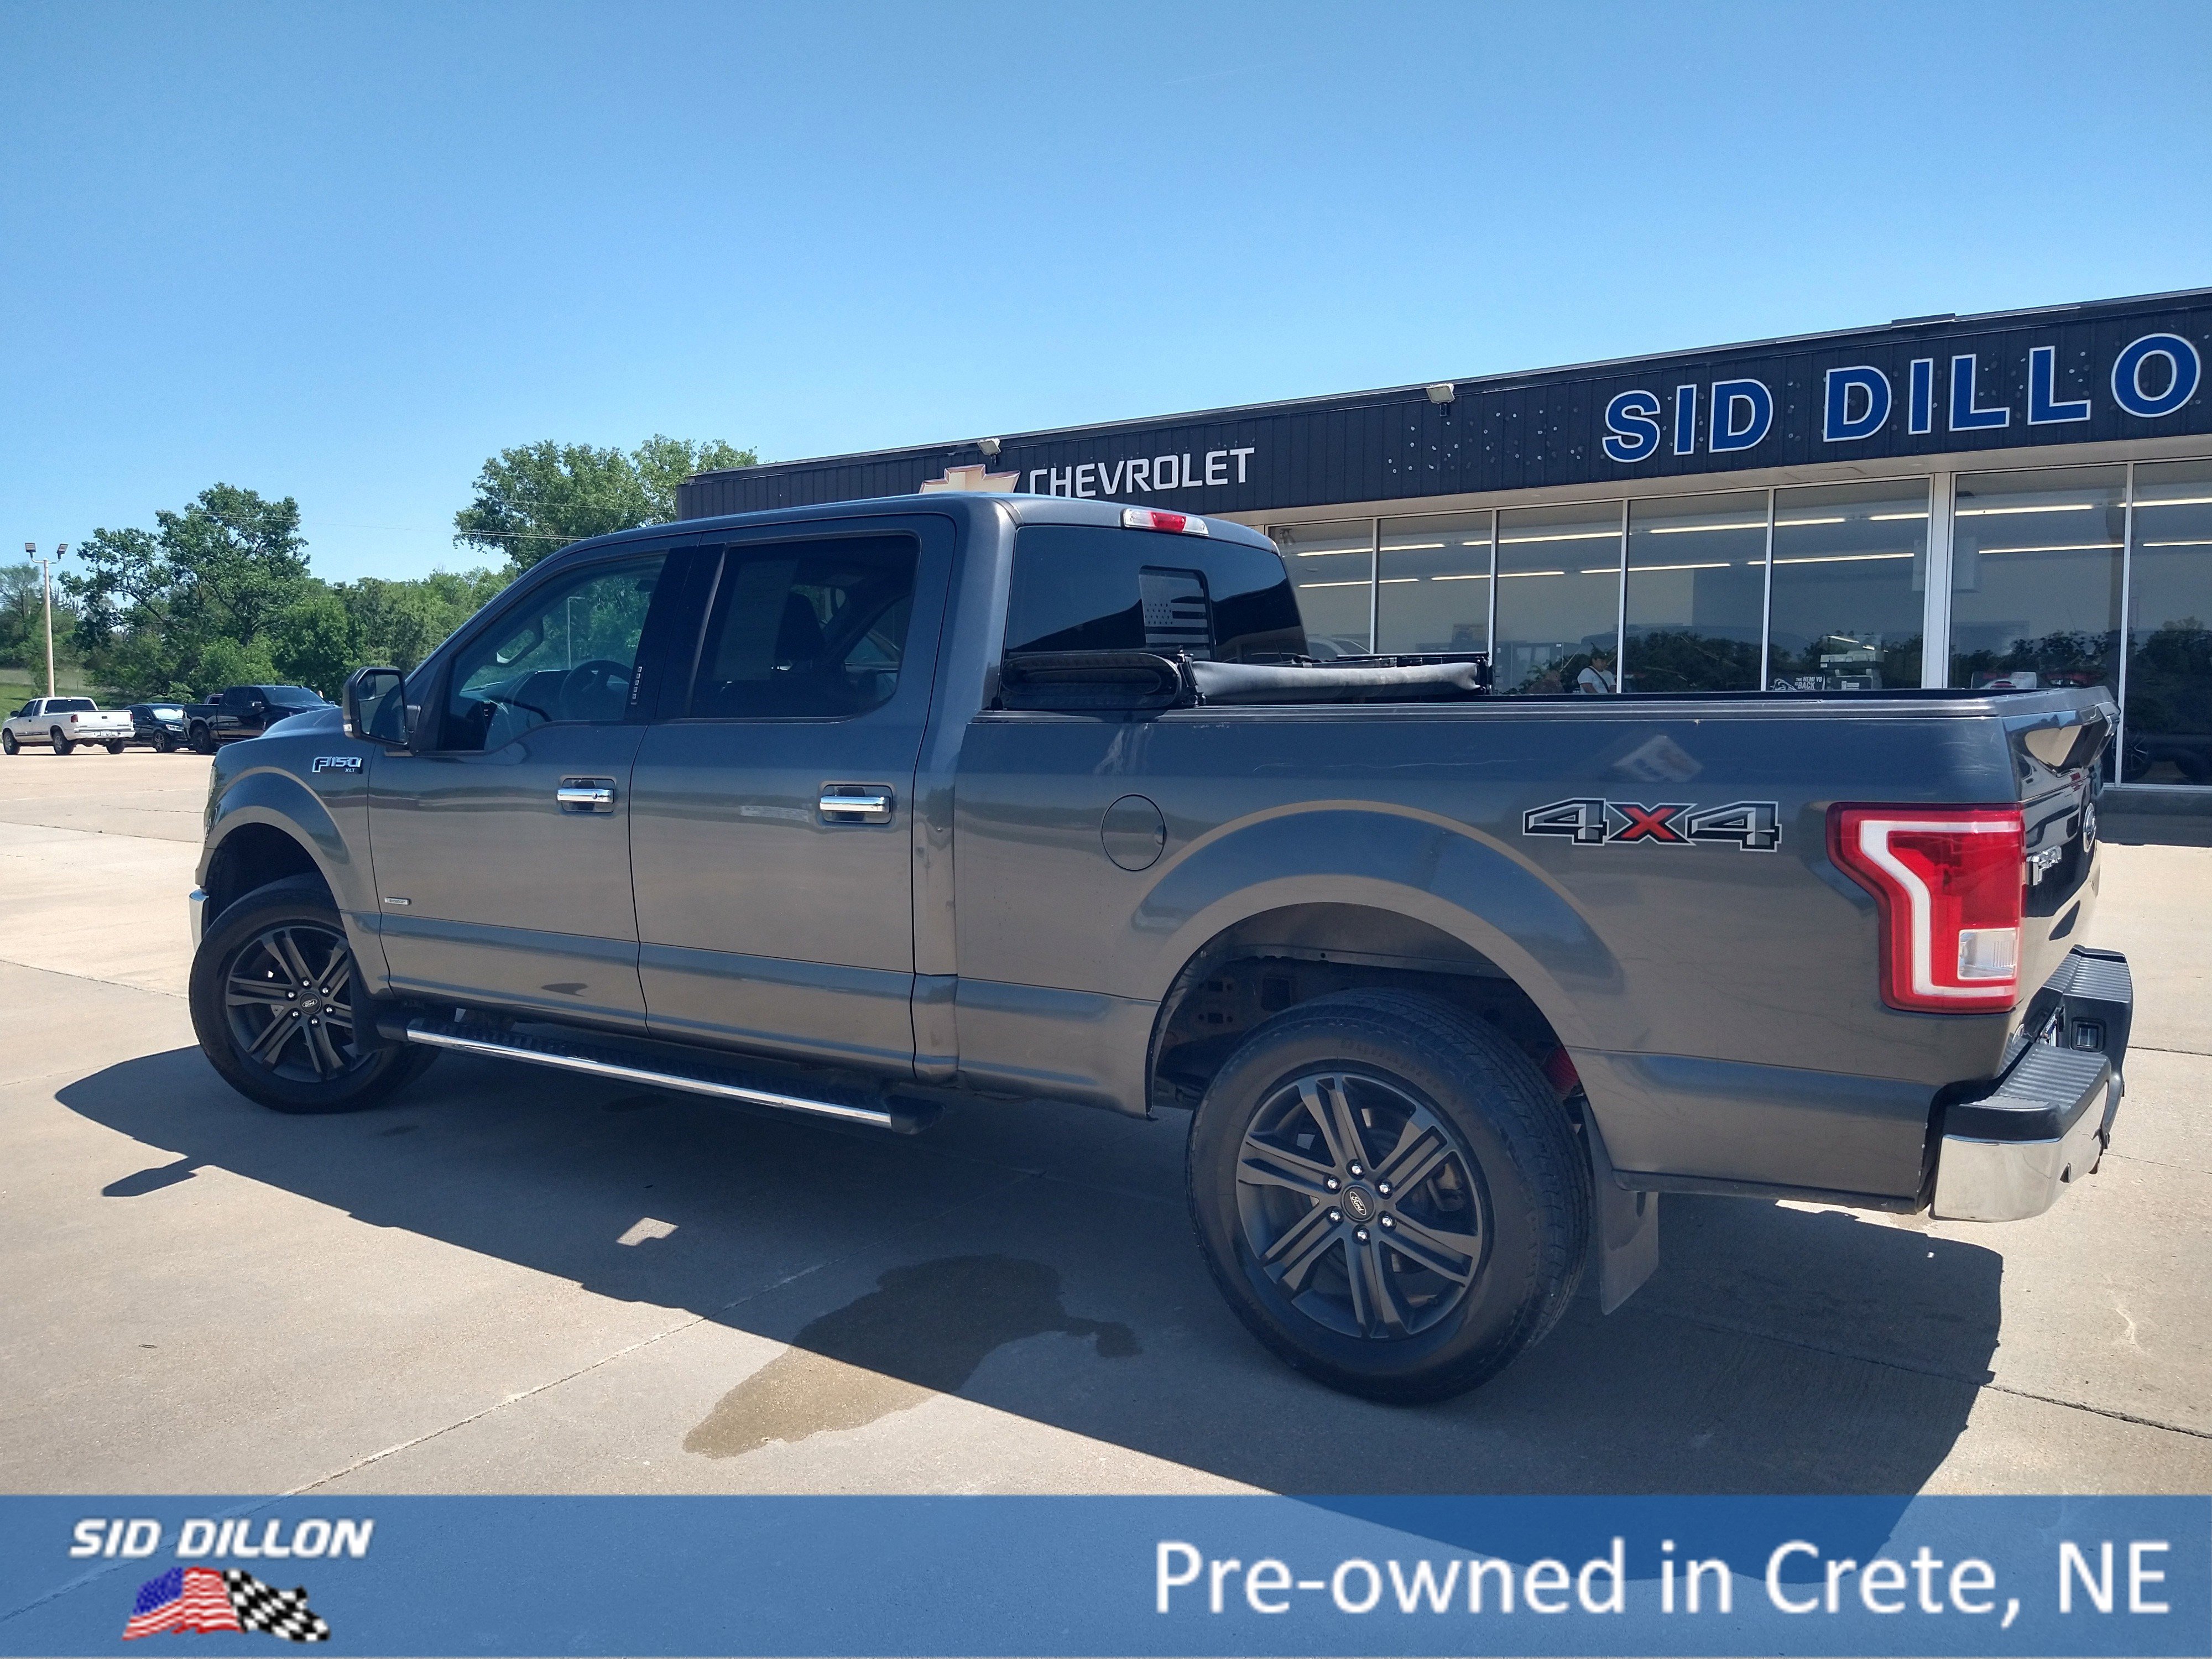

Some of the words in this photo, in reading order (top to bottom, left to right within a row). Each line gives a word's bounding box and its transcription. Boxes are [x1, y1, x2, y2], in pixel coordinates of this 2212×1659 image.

[1602, 378, 1772, 463] SID
[1823, 333, 2200, 441] DILLO
[1029, 447, 1255, 498] CHEVROLET
[1351, 1196, 1364, 1211] Ford
